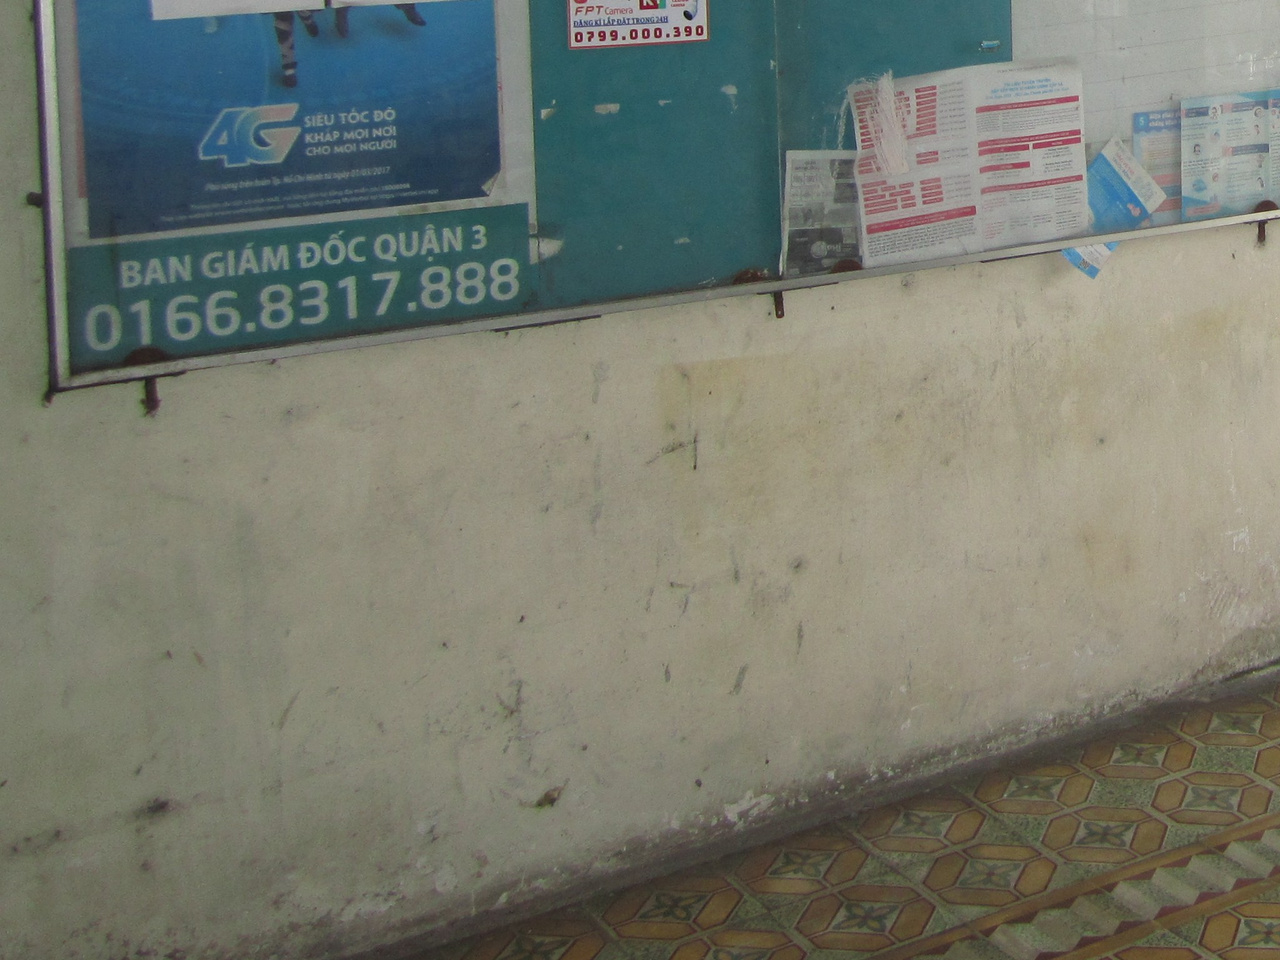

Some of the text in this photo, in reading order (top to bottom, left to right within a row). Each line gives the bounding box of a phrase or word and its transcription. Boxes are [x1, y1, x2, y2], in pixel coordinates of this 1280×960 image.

[575, 5, 633, 17] FPT Camera
[631, 15, 655, 25] TRONG
[656, 15, 669, 23] 24H
[574, 25, 704, 44] 0799.000.390
[304, 110, 335, 127] SIÊU
[340, 107, 370, 124] TỐC
[198, 105, 302, 168] 4G
[306, 145, 330, 157] CHO
[120, 223, 487, 290] BAN GIÁM ĐỐC QUẬN 3
[84, 257, 520, 352] 0166.8317.888
